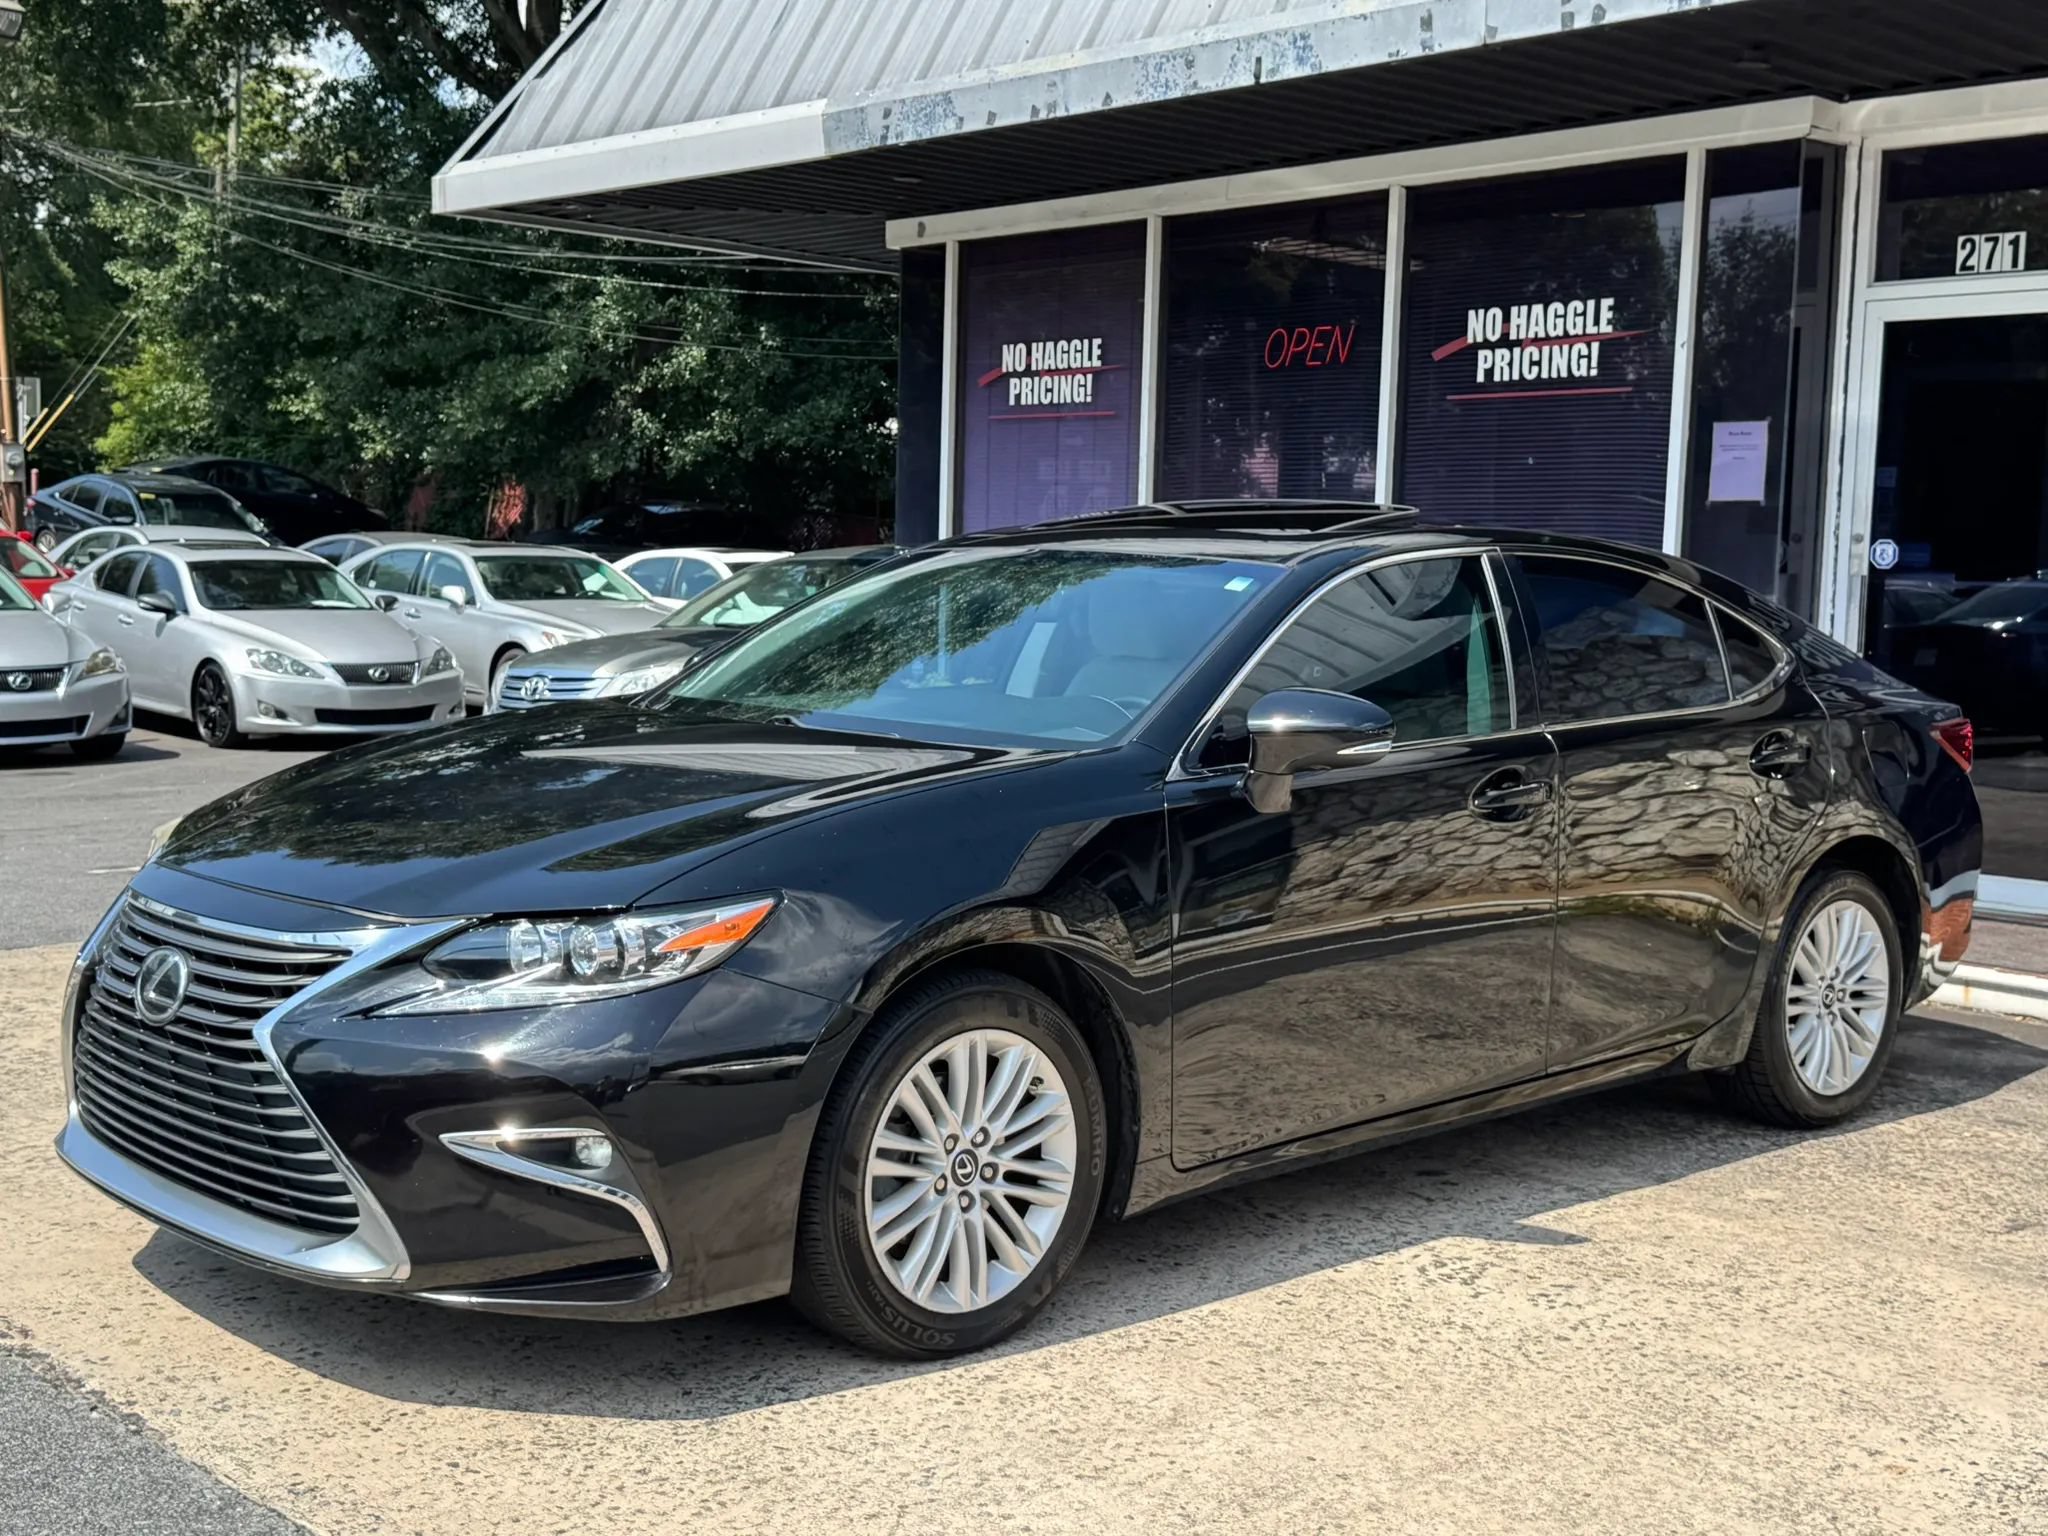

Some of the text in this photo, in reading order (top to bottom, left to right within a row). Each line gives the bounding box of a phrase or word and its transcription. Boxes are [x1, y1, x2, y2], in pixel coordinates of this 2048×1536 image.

[1958, 234, 2021, 272] 271
[1466, 297, 1615, 344] NO HAGGLE
[1001, 337, 1102, 373] NO HAGGLE
[1264, 325, 1355, 368] OPEN
[1476, 341, 1600, 383] PRICING!
[1008, 373, 1094, 406] PRICING!
[881, 1306, 956, 1346] SOLUS
